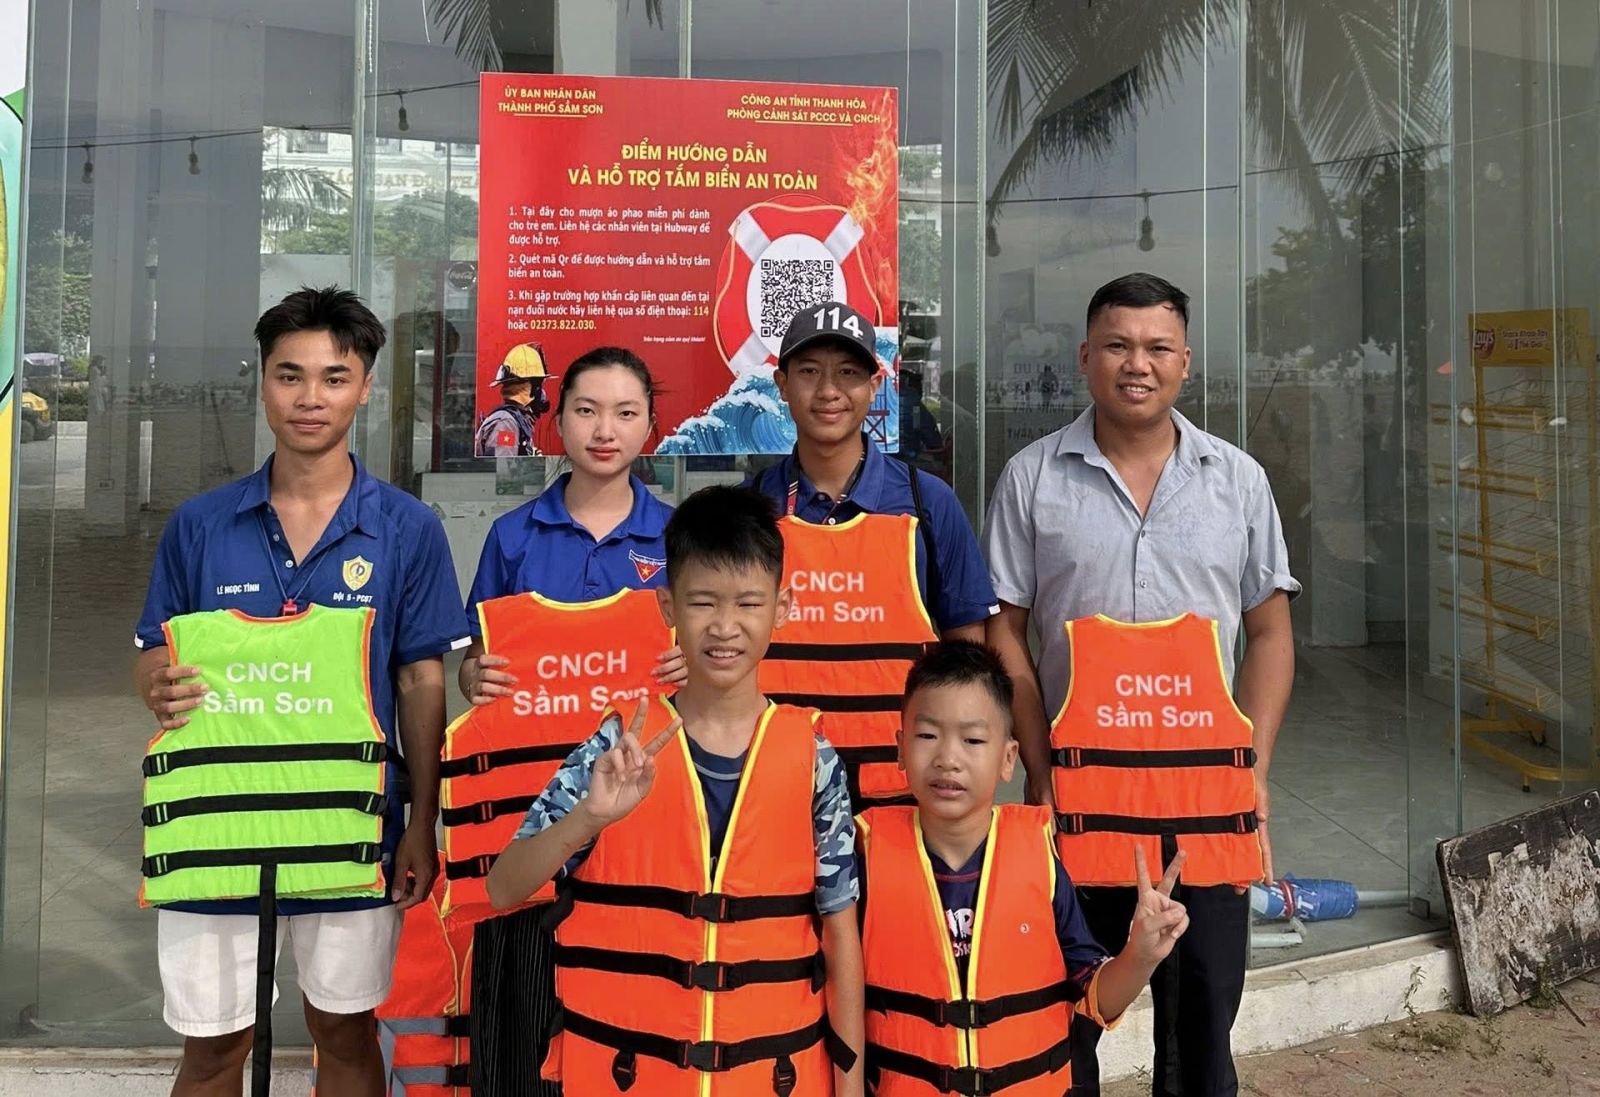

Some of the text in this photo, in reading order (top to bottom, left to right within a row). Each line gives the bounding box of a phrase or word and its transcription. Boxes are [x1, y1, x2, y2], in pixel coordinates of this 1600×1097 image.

[504, 84, 596, 99] ỦY BAN NHÂN DÂN
[498, 100, 604, 114] THÀNH PHỐ SẦM SƠN
[741, 93, 867, 109] CÔNG AN TỈNH THANH HÓA
[727, 107, 881, 123] PHÒNG CẢNH SÁT PCCC VÀ CNCH
[621, 136, 767, 163] ĐIỂM HƯỚNG DẪN
[567, 162, 818, 191] VÀ HỖ TRỢ TẮM BIỂN AN TOÀN
[509, 204, 710, 221] 1. Tại đây cho mượn áo phao miễn phí dành
[508, 220, 524, 231] cho
[526, 220, 540, 231] trẻ
[541, 222, 557, 231] em.
[559, 220, 577, 231] Liên
[579, 220, 590, 233] hệ
[592, 221, 607, 232] các
[608, 220, 629, 232] nhân
[631, 220, 649, 233] viên
[651, 221, 663, 235] tại
[664, 222, 698, 236] Hubway
[509, 231, 561, 248] được hỗ trợ.
[508, 253, 517, 264] 2.
[519, 252, 541, 266] Quét
[542, 253, 557, 264] mã
[558, 254, 569, 266] Qr
[583, 254, 606, 267] được
[607, 253, 634, 267] hướng
[636, 251, 652, 266] dẫn
[654, 254, 665, 265] và
[666, 252, 678, 266] hỗ
[679, 255, 692, 268] trợ
[694, 254, 711, 266] tắm
[508, 265, 565, 278] biển an toàn.
[508, 288, 710, 304] 3. Khi gặp trường hợp khẩn cấp liên quan đến tại
[508, 306, 524, 318] nạn
[546, 304, 568, 316] nước
[569, 304, 586, 317] hãy
[587, 304, 603, 316] liên
[605, 304, 616, 318] hệ
[617, 306, 634, 318] qua
[635, 304, 646, 316] số
[646, 305, 665, 318] điện
[667, 305, 692, 318] thoại:
[693, 305, 709, 316] 114
[507, 319, 597, 332] hoặc 02373.822.030.
[813, 306, 864, 339] 114
[790, 570, 865, 592] CNCH
[788, 596, 885, 622] ầm Sơn
[225, 661, 312, 683] CNCH
[537, 649, 627, 679] CNCH
[1115, 674, 1193, 697] CNCH
[203, 688, 334, 714] Sầm Sơn
[513, 684, 580, 716] Sầm
[1097, 701, 1214, 728] Sầm Sơn
